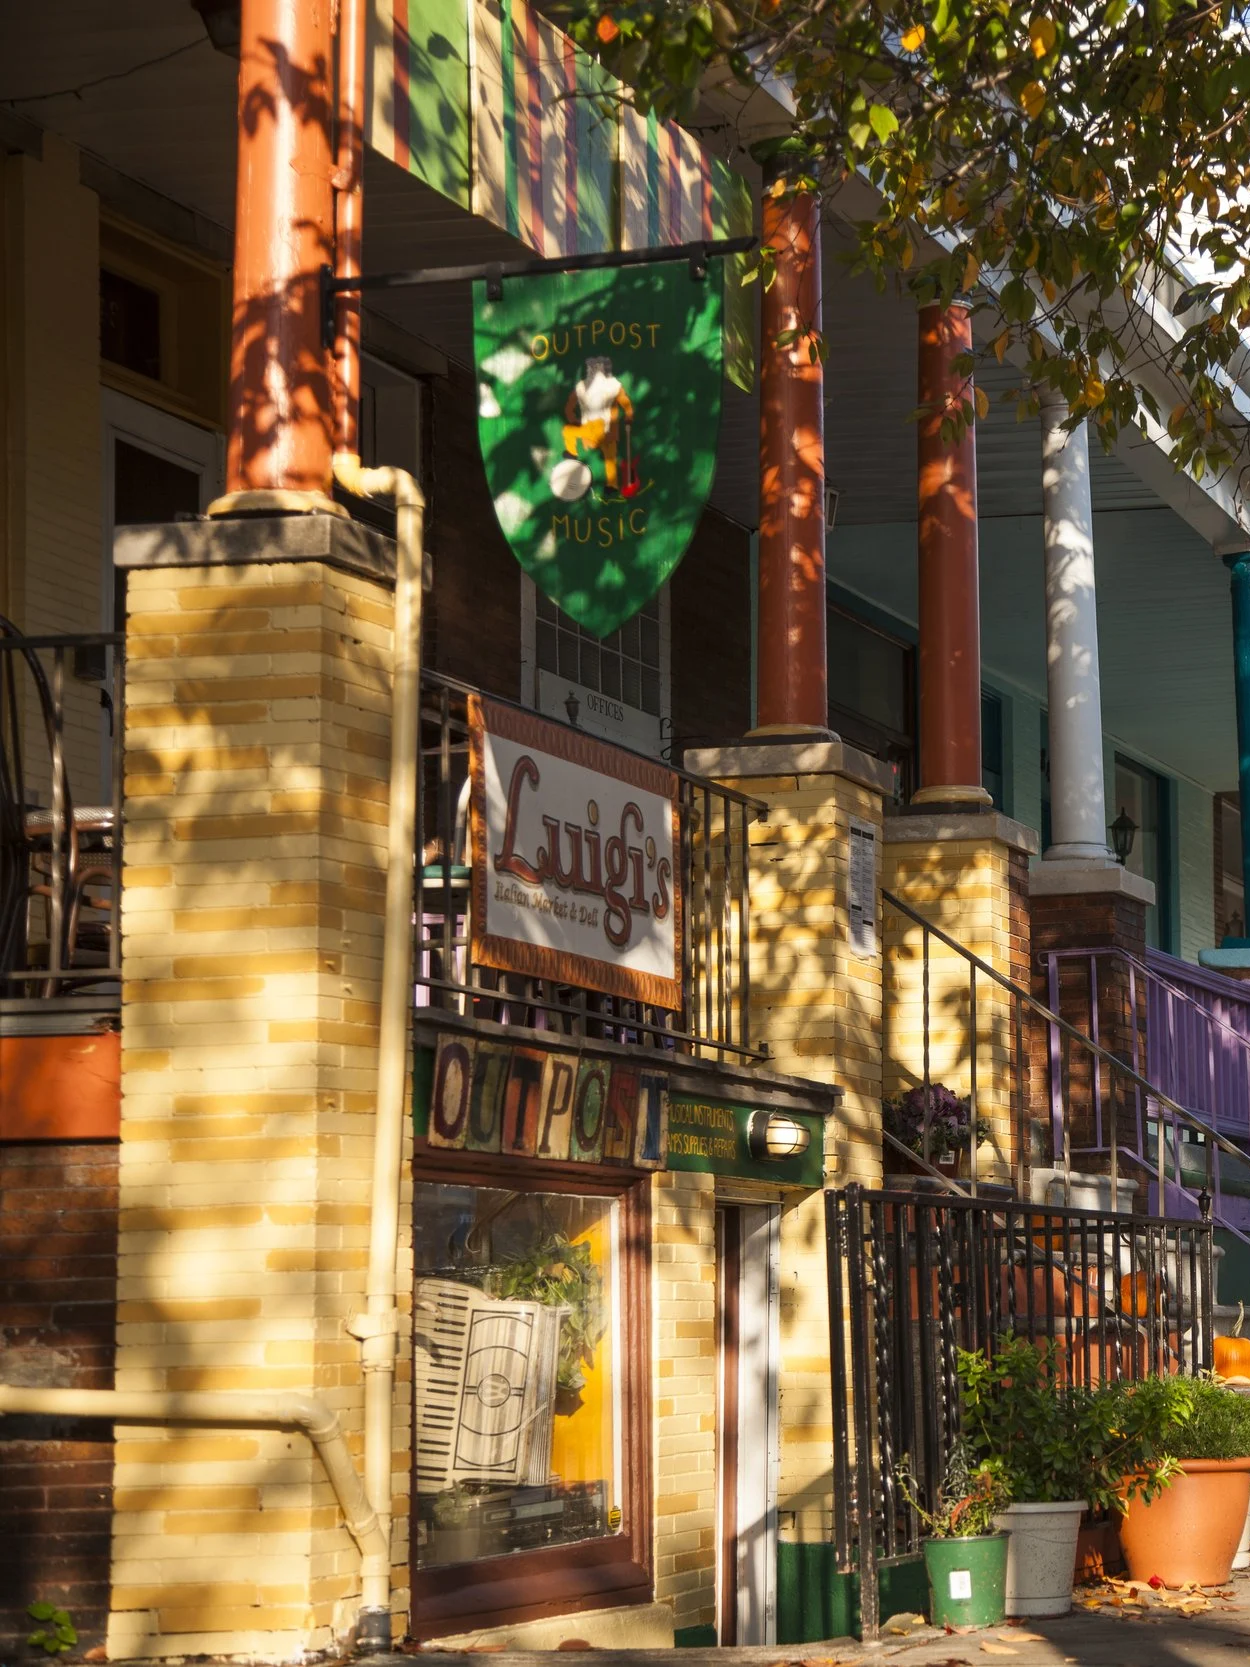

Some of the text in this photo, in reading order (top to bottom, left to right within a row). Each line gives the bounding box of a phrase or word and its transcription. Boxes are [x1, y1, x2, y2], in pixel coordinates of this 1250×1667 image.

[531, 319, 661, 361] OUTPOST
[587, 693, 624, 722] OFFICES
[493, 755, 671, 947] Luigi's
[494, 880, 599, 928] Italian Market & Deli
[433, 1042, 669, 1161] OUTPOST
